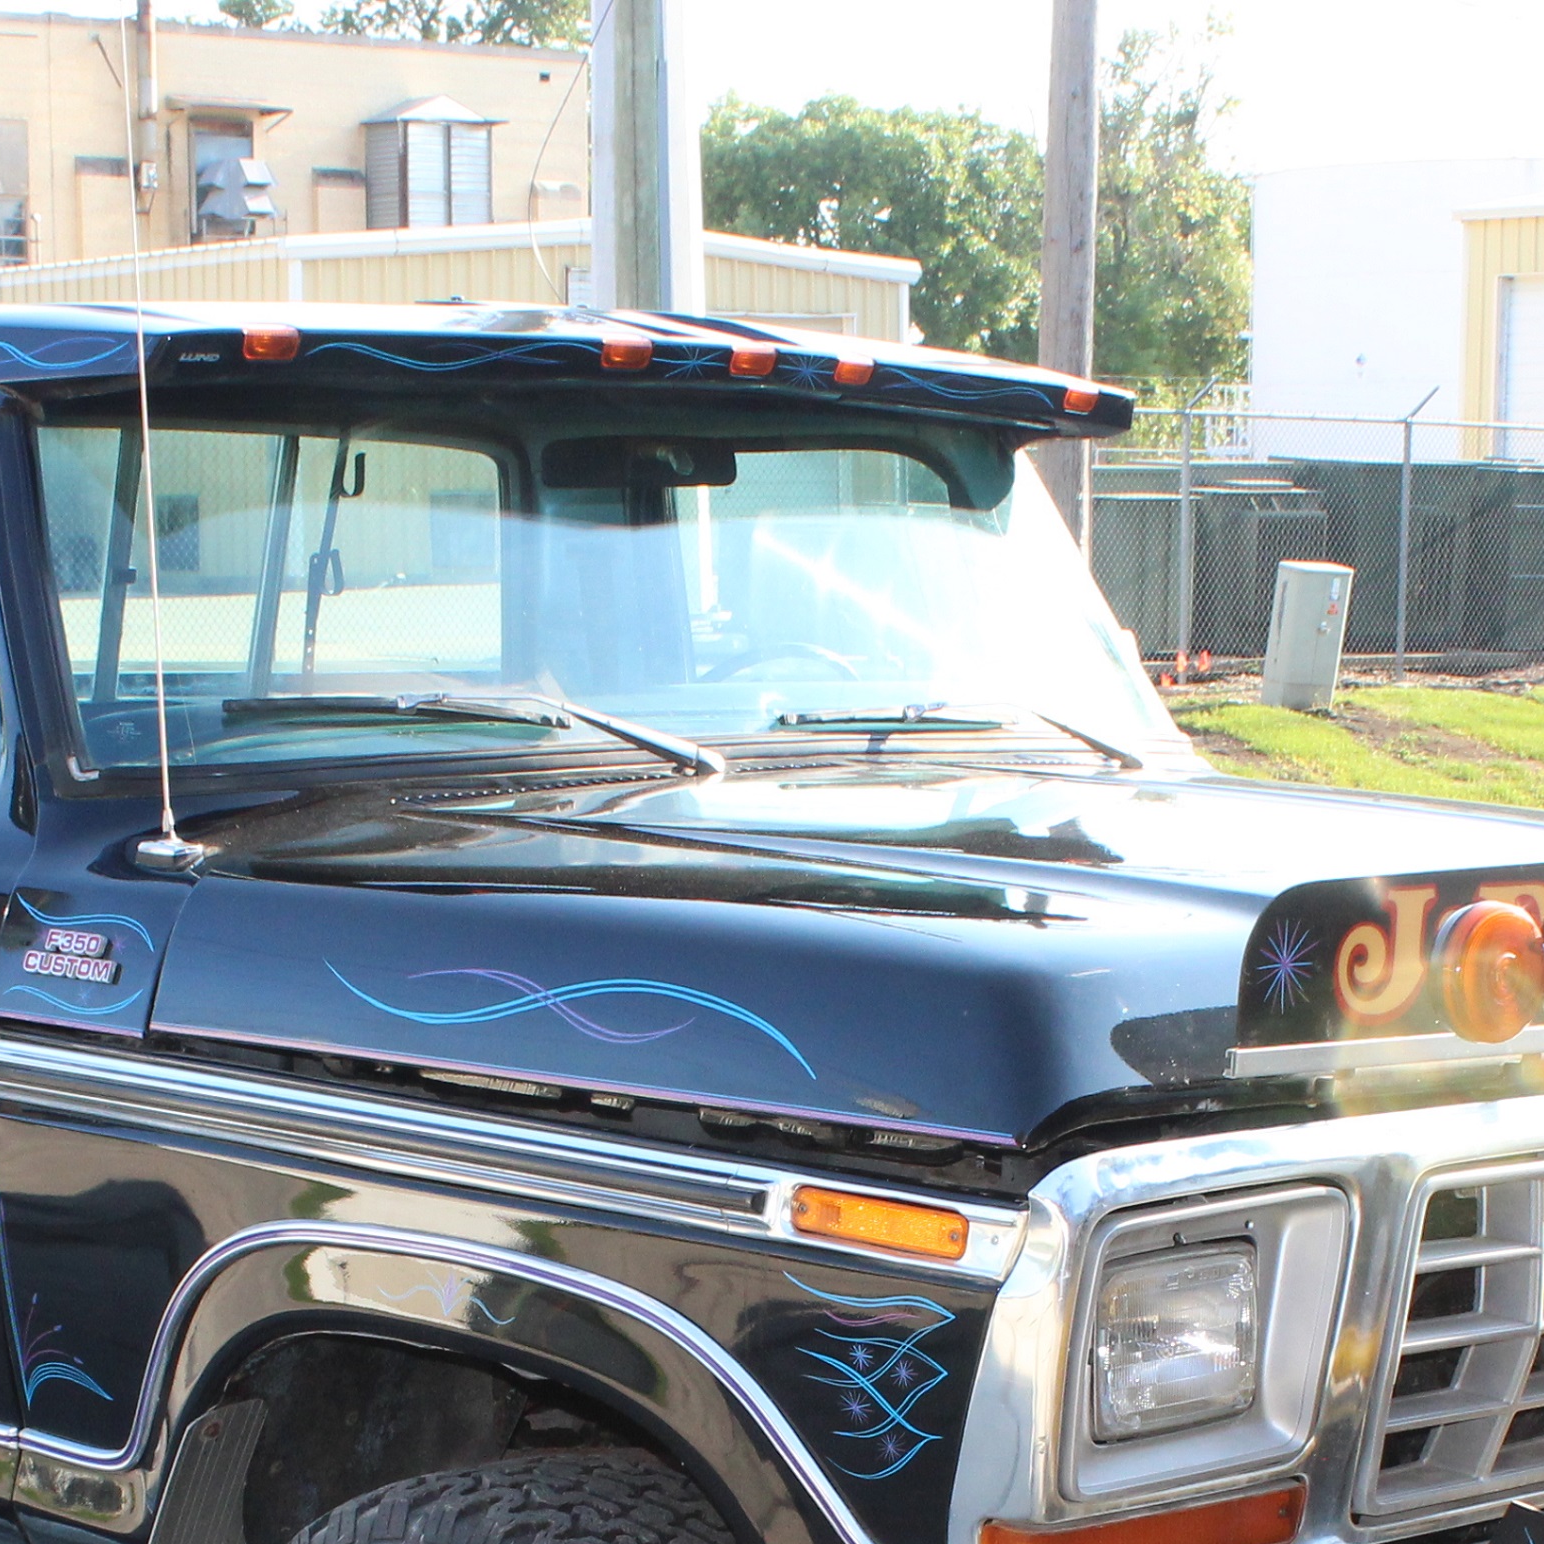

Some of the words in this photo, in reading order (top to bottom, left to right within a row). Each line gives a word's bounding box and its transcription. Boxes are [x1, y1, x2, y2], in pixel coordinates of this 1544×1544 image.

[179, 352, 220, 362] LUND
[45, 929, 103, 955] F350
[23, 951, 113, 983] CUSTOM
